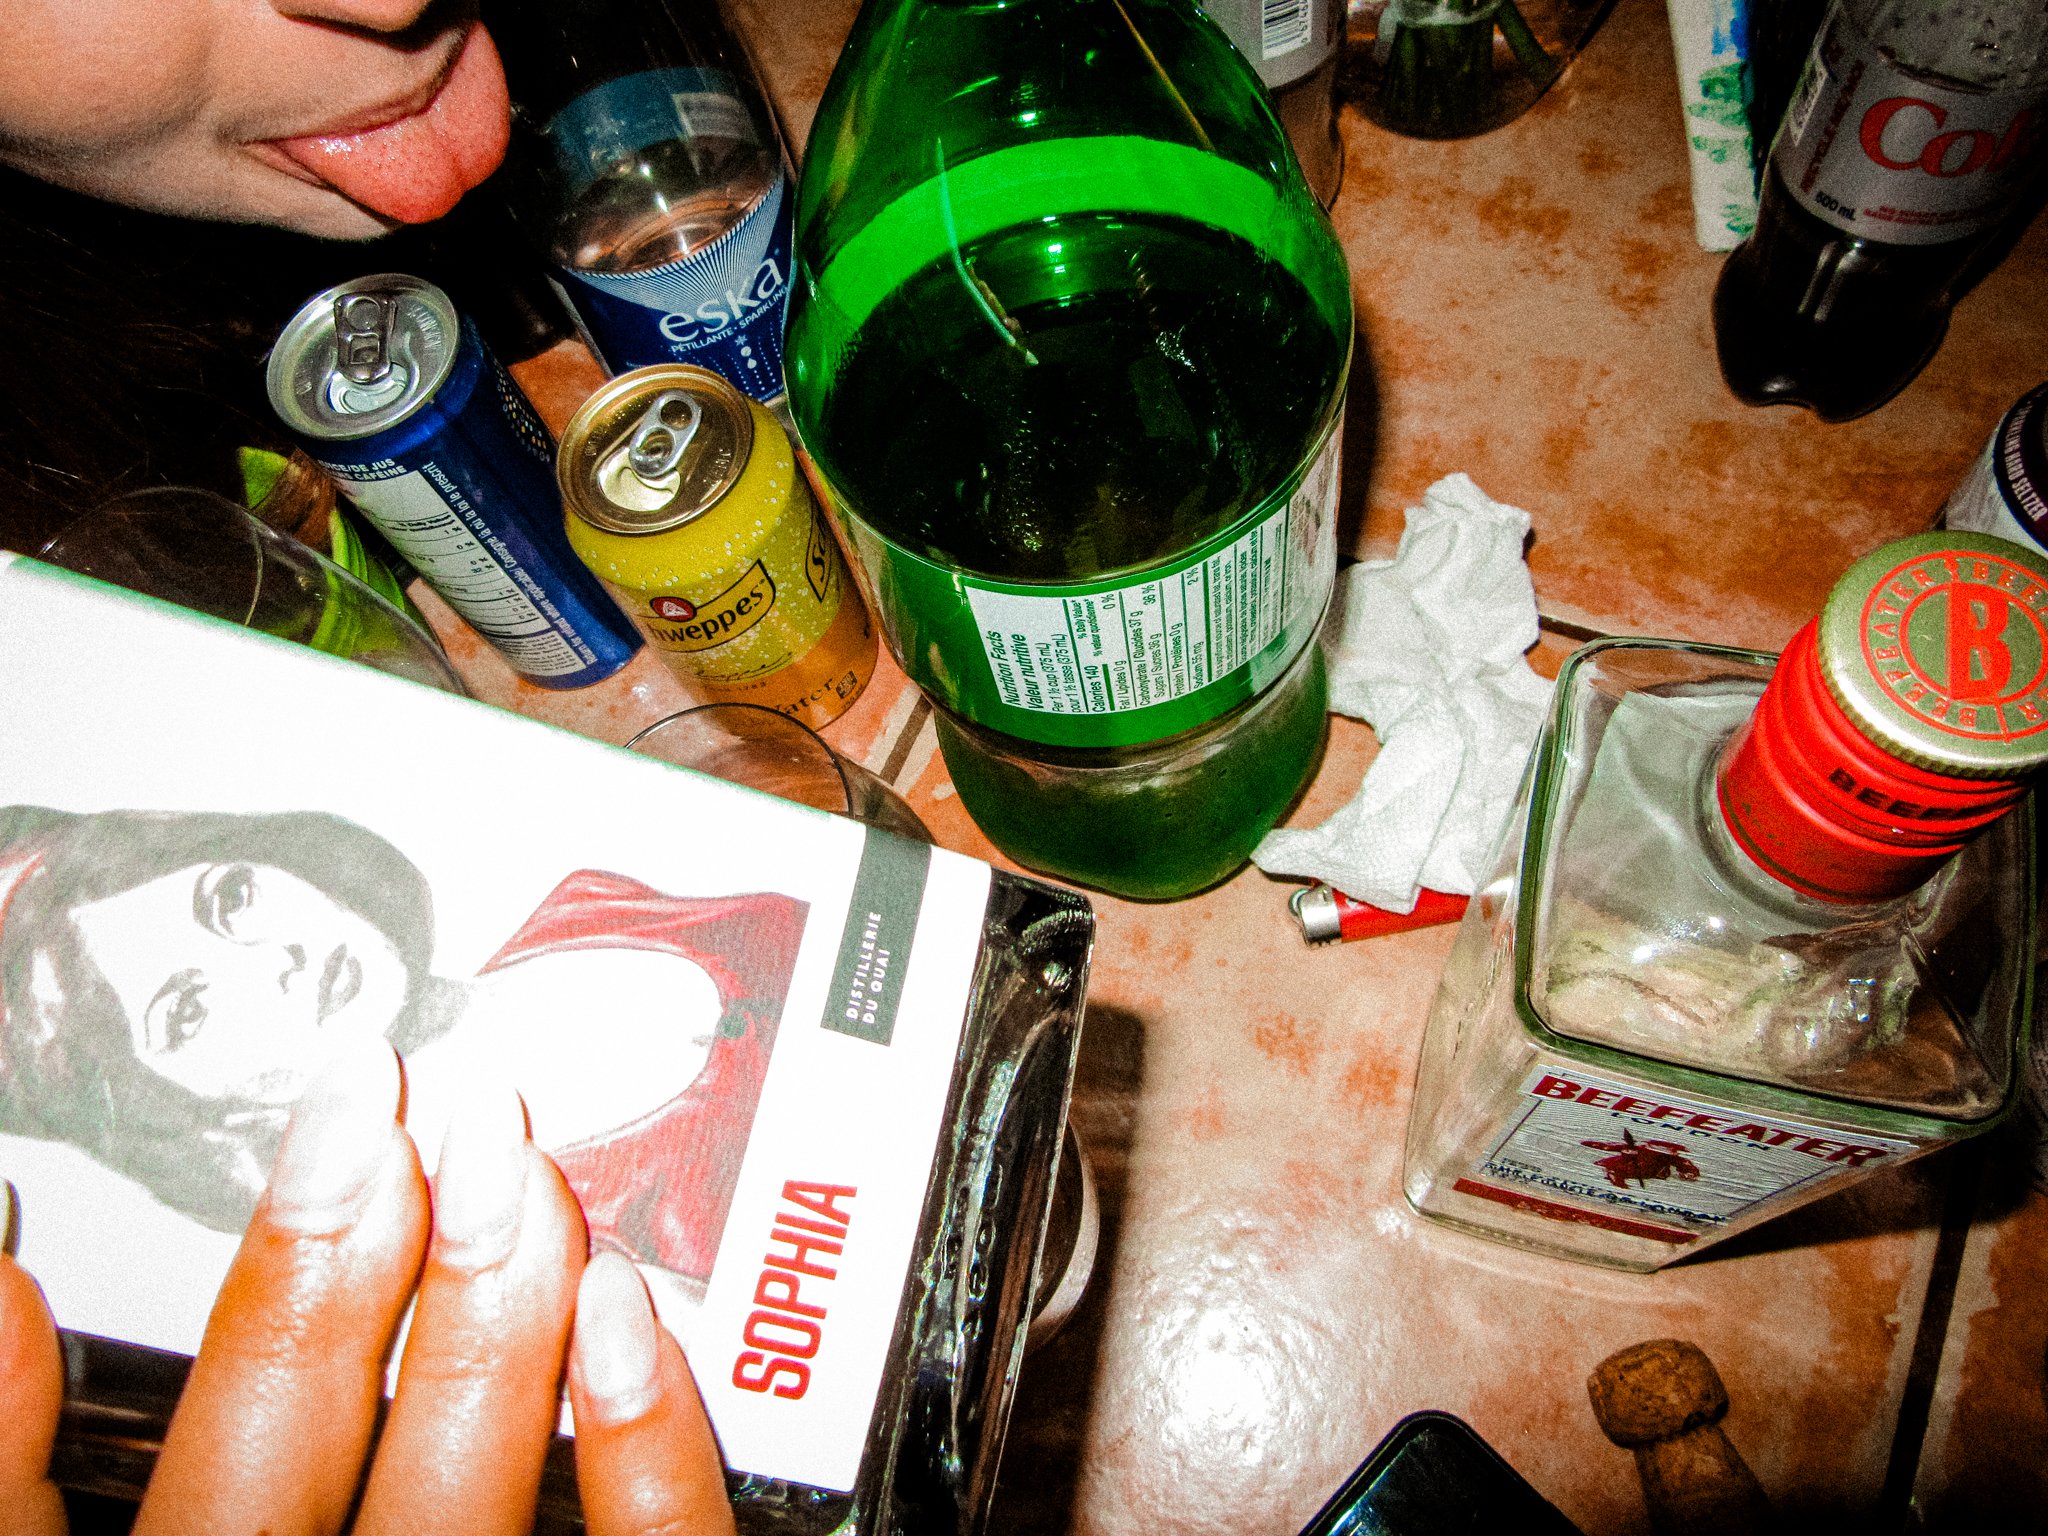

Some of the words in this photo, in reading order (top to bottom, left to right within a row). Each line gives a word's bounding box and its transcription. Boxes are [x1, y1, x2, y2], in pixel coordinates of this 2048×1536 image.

[659, 257, 784, 342] eska
[670, 326, 735, 354] PÉTILLANTE
[371, 458, 396, 471] JUS
[2004, 450, 2026, 481] HARD
[422, 461, 458, 493] prescrit
[449, 491, 463, 503] le
[2011, 476, 2048, 522] SELTZER
[453, 499, 471, 513] loi
[1186, 567, 1198, 577] %
[1142, 583, 1155, 594] %
[1187, 577, 1199, 586] 2
[1101, 593, 1115, 603] %
[1143, 594, 1156, 606] 36
[1130, 610, 1143, 618] g
[1075, 619, 1086, 633] Daily
[1129, 618, 1142, 628] 37
[1171, 622, 1183, 630] g
[986, 630, 1008, 661] Facts
[1051, 633, 1067, 648] mL)
[1089, 634, 1102, 650] valeur
[1131, 628, 1145, 659] Glucides
[1148, 640, 1162, 650] 36
[1193, 641, 1205, 656] mg
[1011, 633, 1036, 678] nutritive
[1035, 642, 1051, 657] mL)
[1055, 649, 1073, 666] (375
[1039, 657, 1058, 673] (375
[1151, 650, 1162, 673] Sucres
[1192, 656, 1202, 665] 55
[1046, 674, 1060, 687] cup
[1061, 665, 1075, 684] tasse
[1084, 665, 1099, 680] 140
[1193, 664, 1204, 689] Sodium
[997, 662, 1021, 706] Nutrition
[1116, 672, 1130, 693] Lipides
[1135, 663, 1151, 706] Carbohydrate
[1154, 675, 1168, 698] Sugars
[1174, 672, 1185, 697] Protein
[1023, 678, 1044, 709] Valeur
[1089, 681, 1106, 713] Calories
[1051, 701, 1064, 713] Per
[1069, 701, 1084, 713] pour
[1119, 699, 1131, 711] Fat
[845, 911, 882, 1021] DISTILLERIE
[861, 1000, 877, 1025] DU
[869, 948, 890, 995] QUAI
[1531, 1074, 1888, 1167] BEEFEATER
[1611, 1111, 1770, 1152] LONDON
[732, 1179, 858, 1401] SOPHIA
